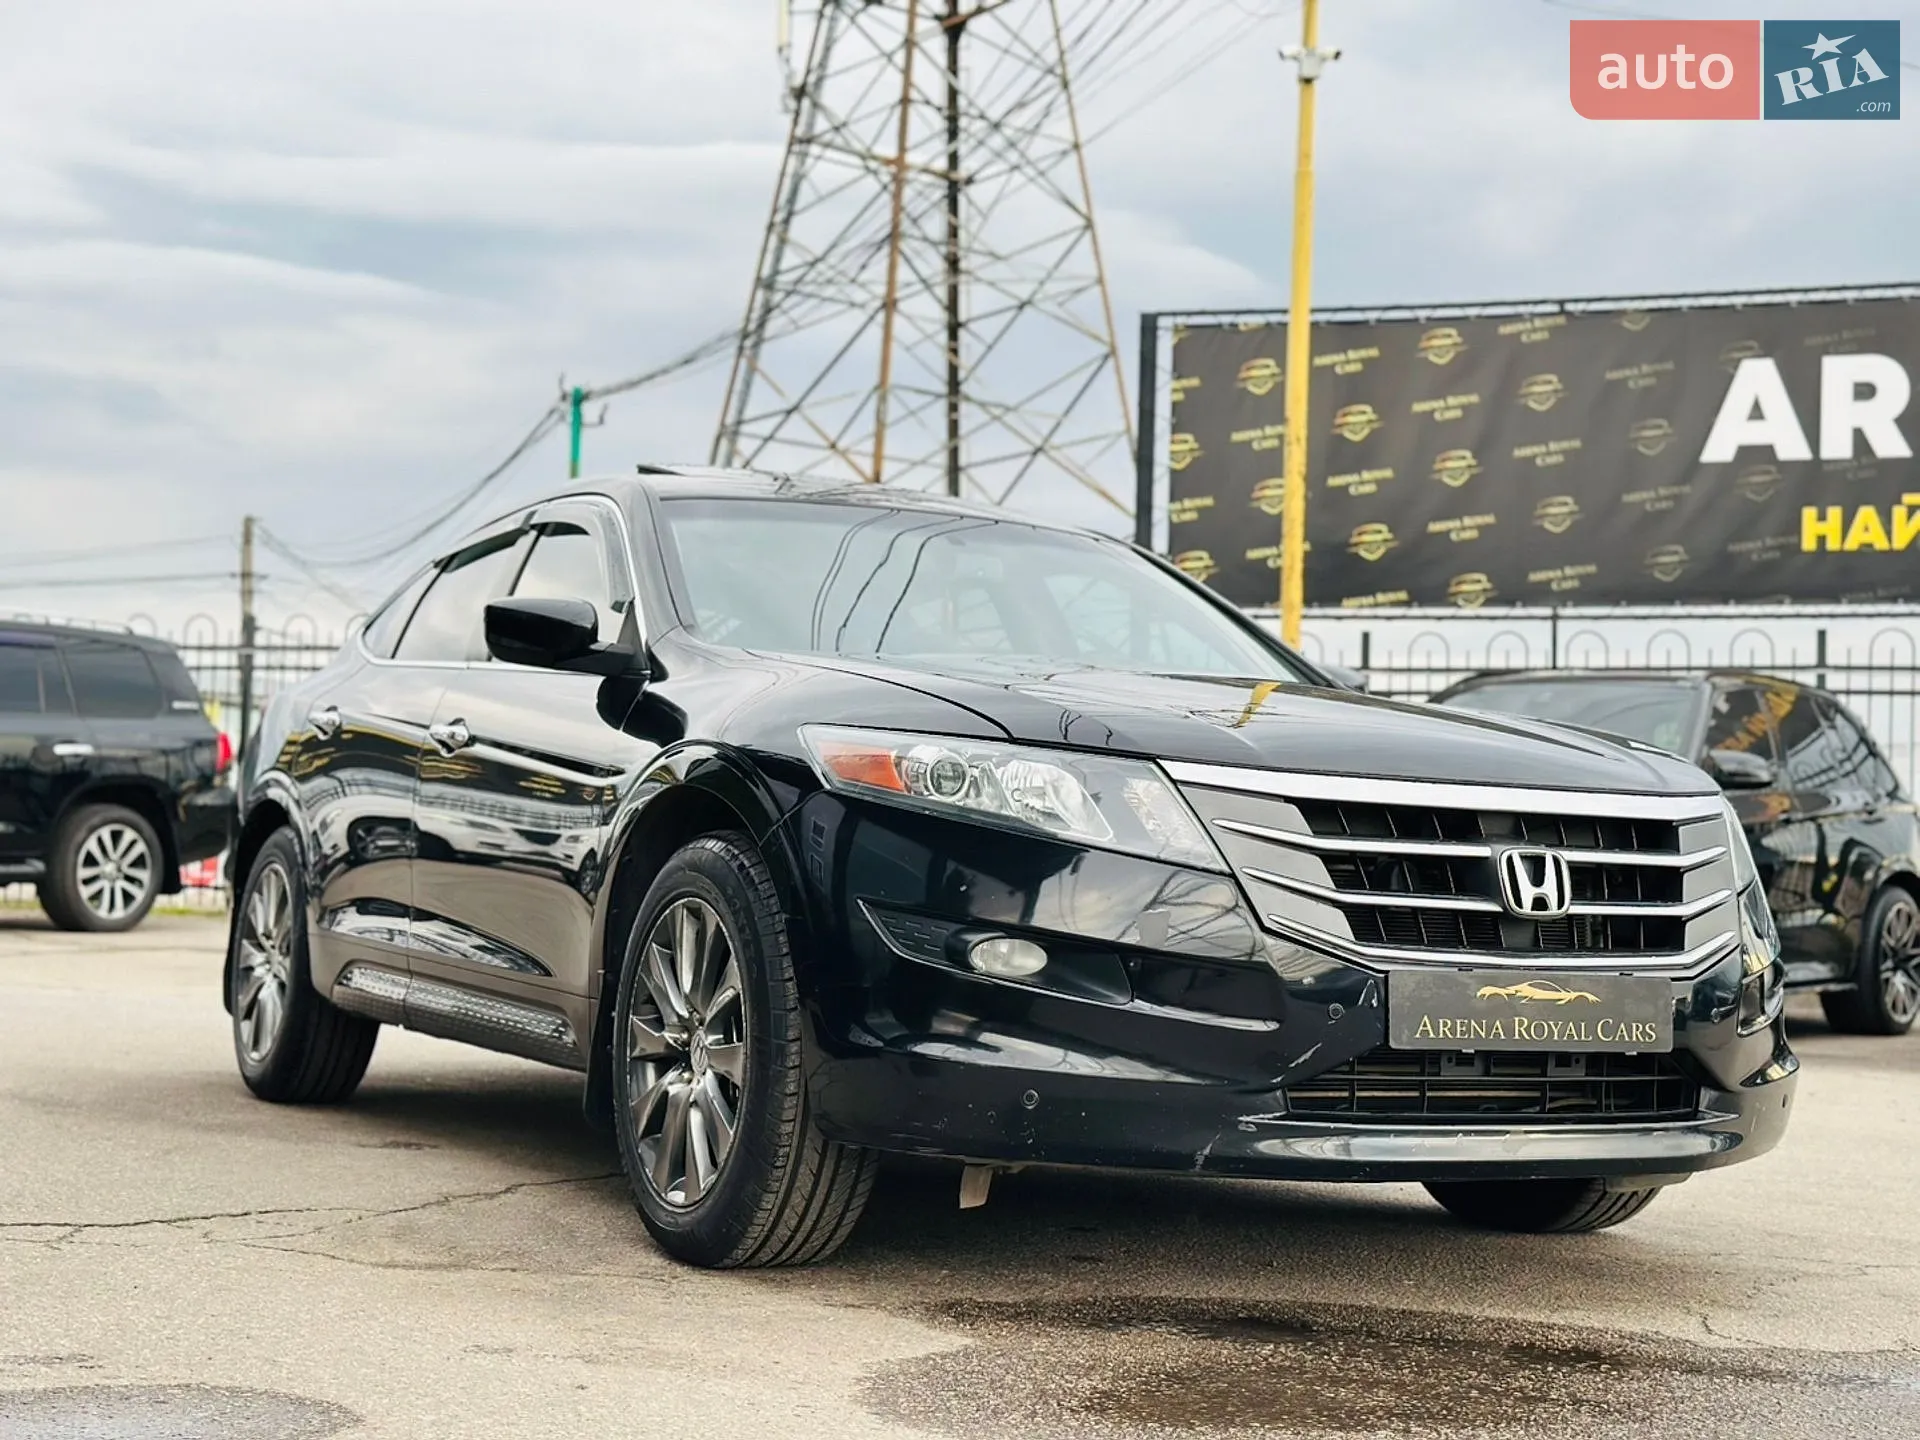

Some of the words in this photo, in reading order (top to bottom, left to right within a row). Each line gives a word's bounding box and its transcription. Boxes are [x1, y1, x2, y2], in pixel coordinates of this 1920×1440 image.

[1699, 353, 1913, 463] AR
[1415, 1015, 1506, 1040] ARENA
[1513, 1017, 1592, 1041] ROYAL
[1597, 1018, 1656, 1043] CARS
